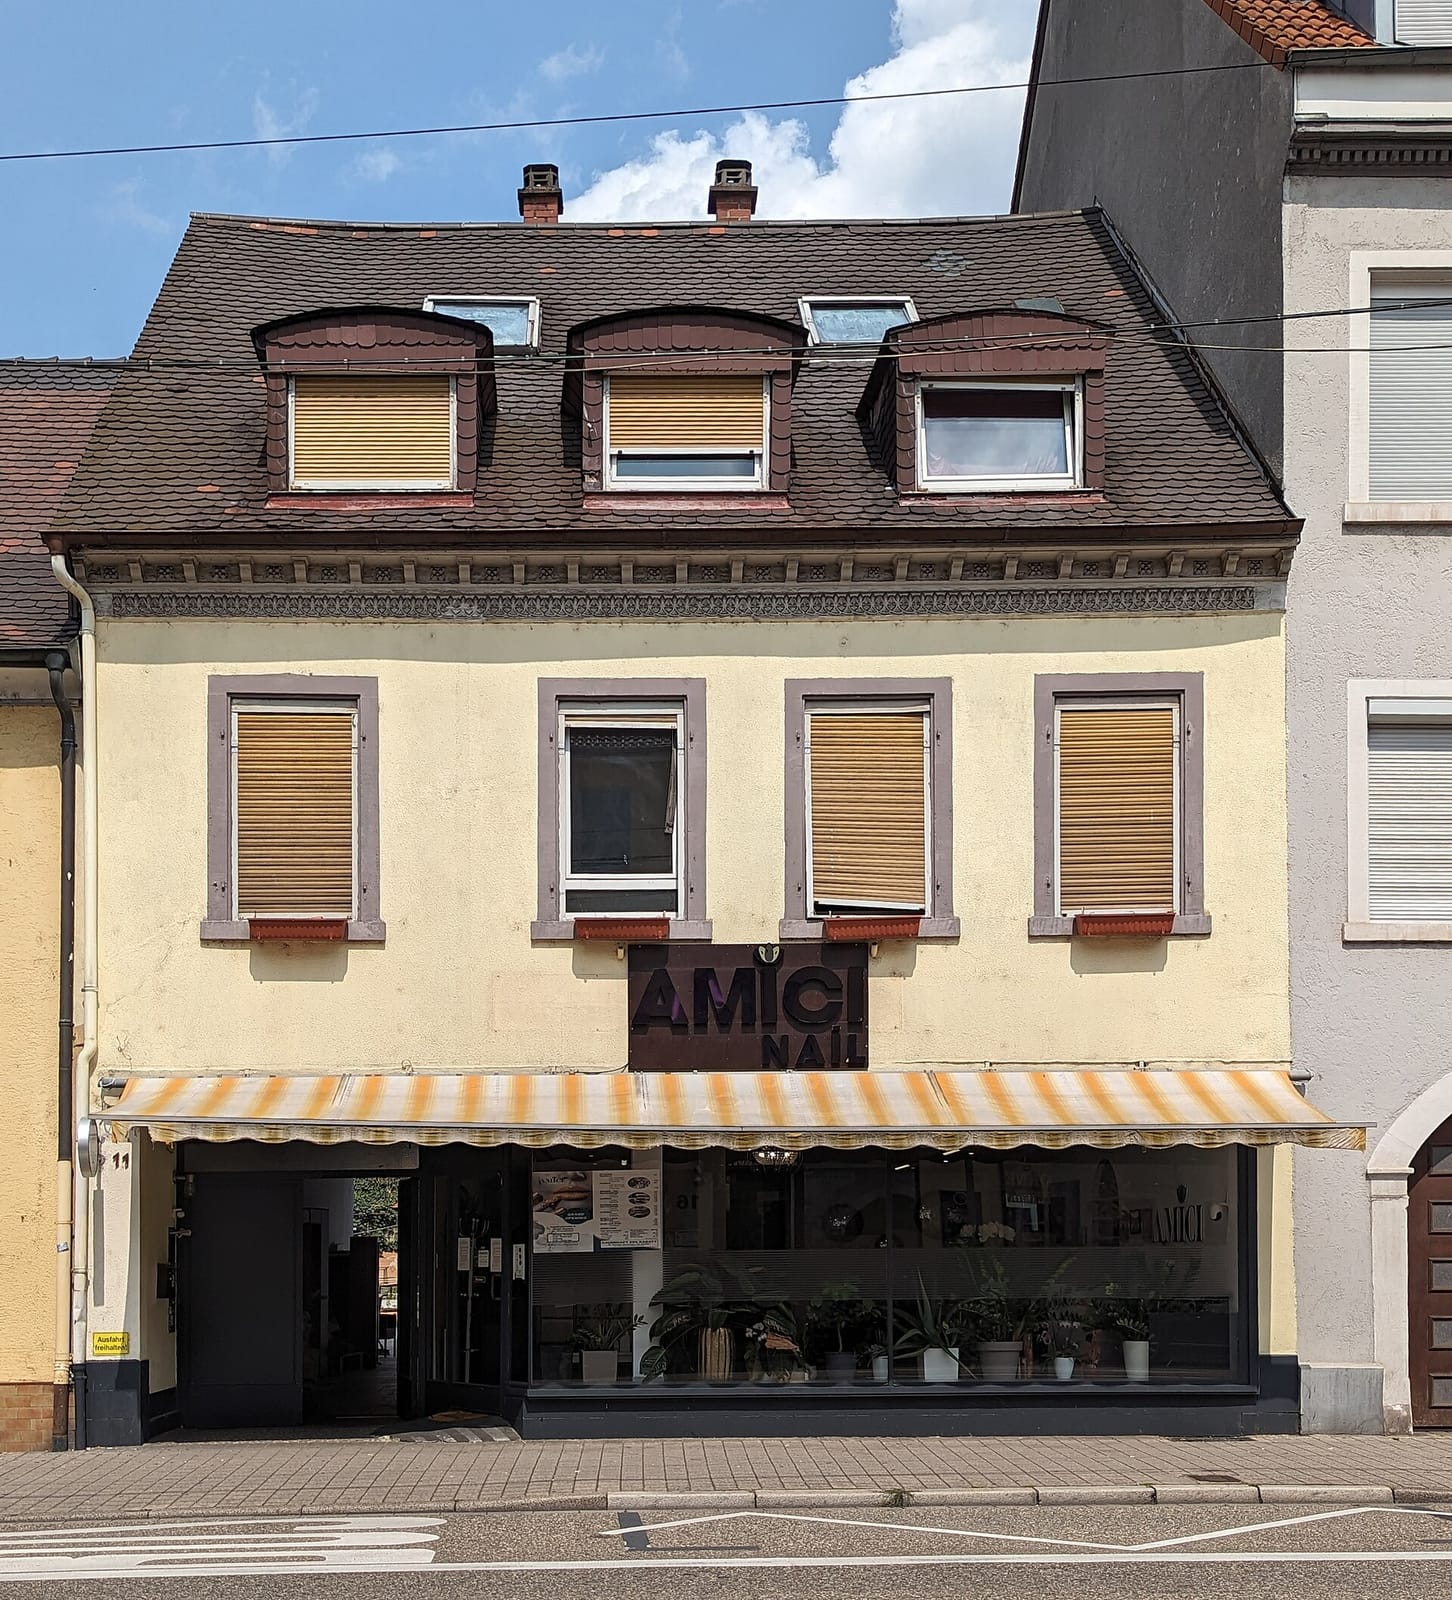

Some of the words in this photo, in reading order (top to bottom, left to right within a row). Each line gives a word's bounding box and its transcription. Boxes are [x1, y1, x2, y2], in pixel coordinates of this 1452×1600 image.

[631, 964, 865, 1033] AMICI
[112, 1151, 129, 1170] 11
[1152, 1204, 1204, 1243] AMICI
